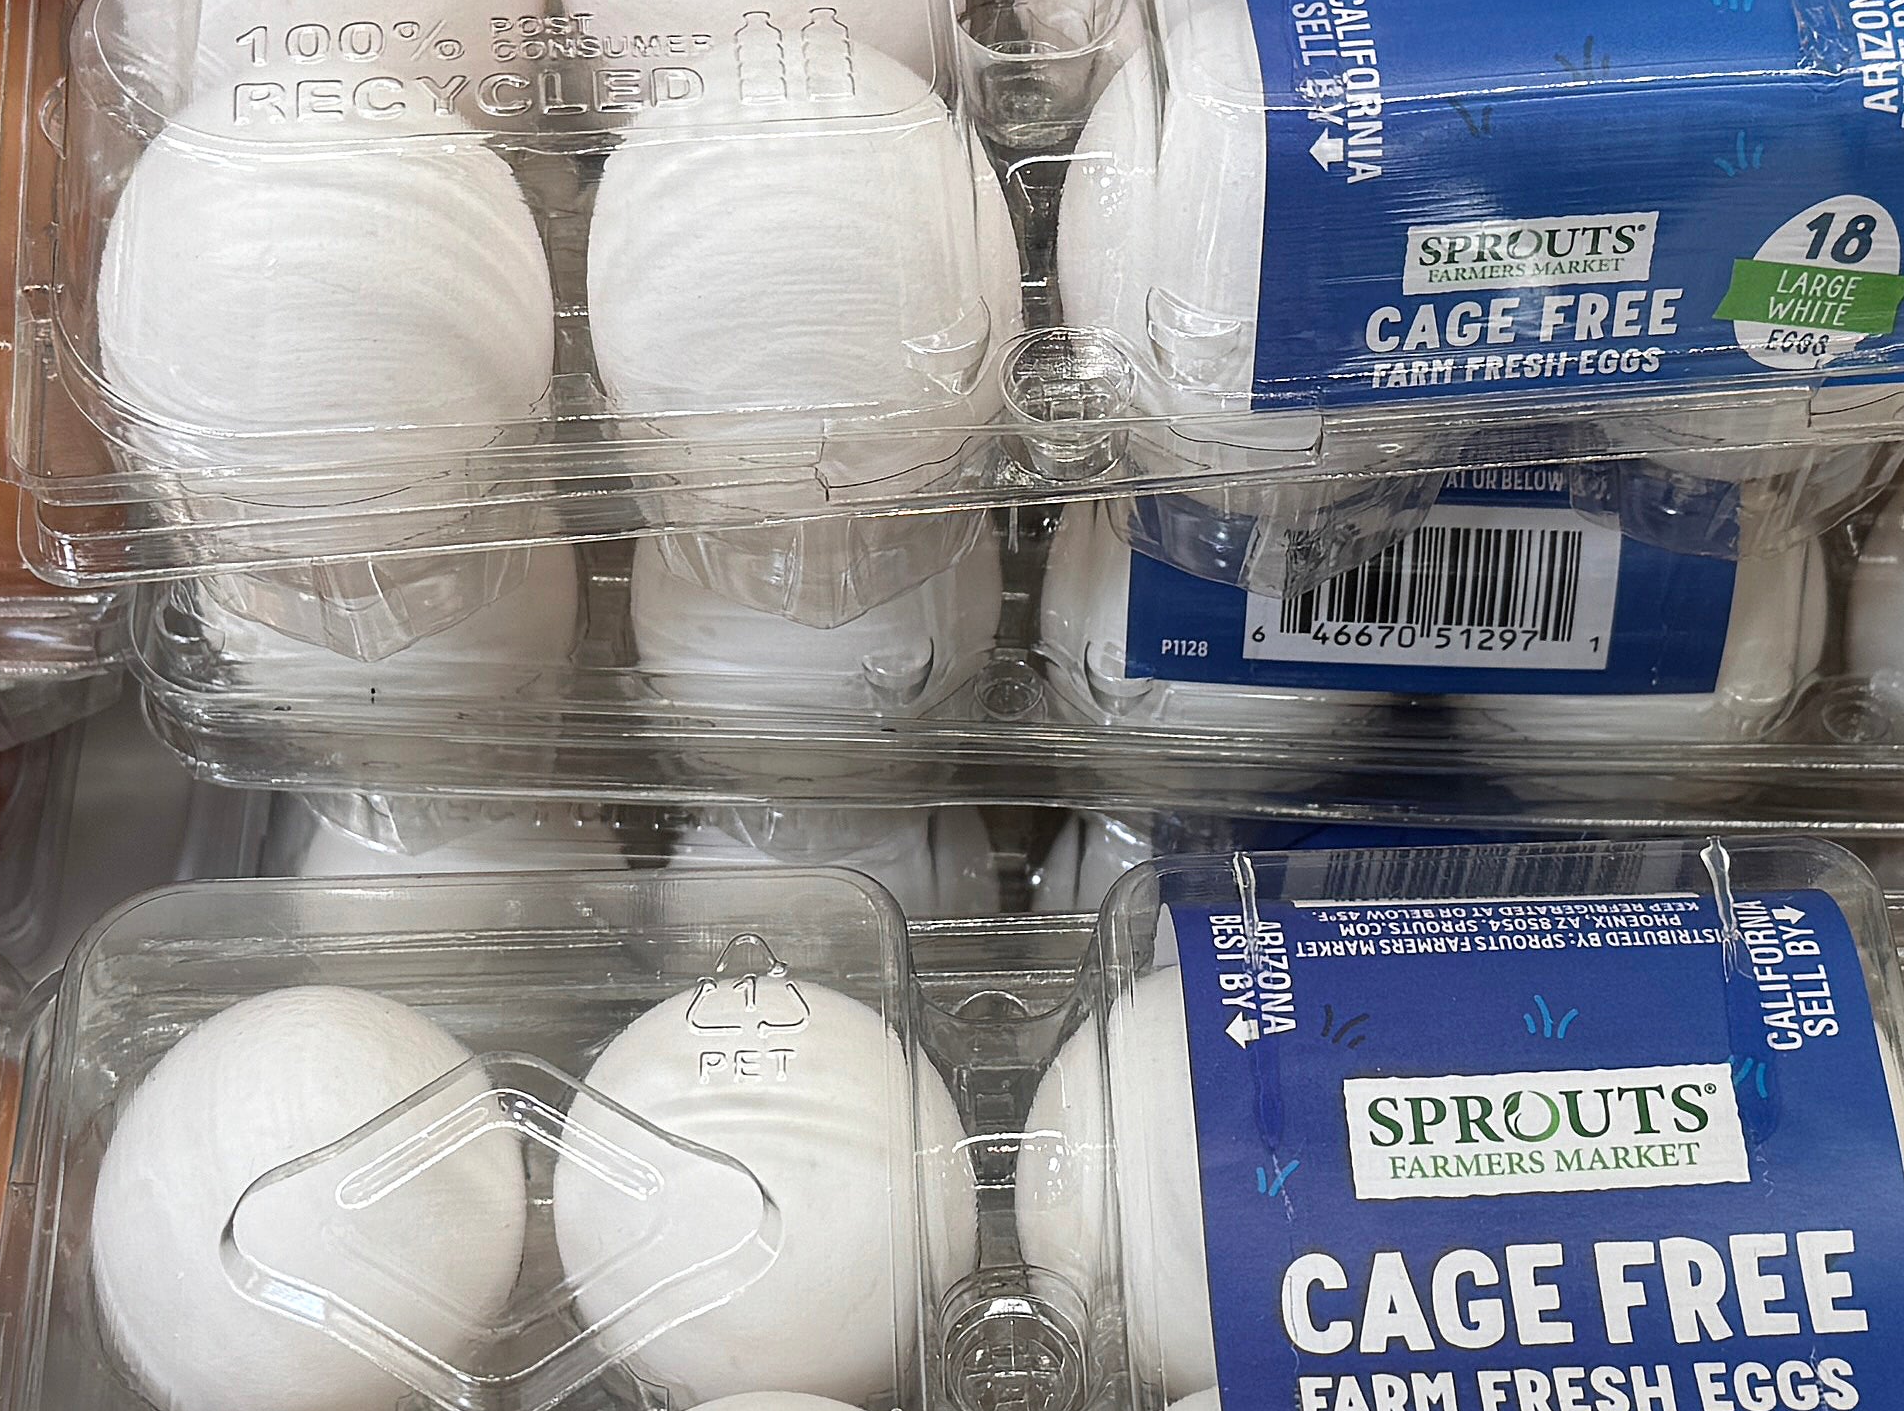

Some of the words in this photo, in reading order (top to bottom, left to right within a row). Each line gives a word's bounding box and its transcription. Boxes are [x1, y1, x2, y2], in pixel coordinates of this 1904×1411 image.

[235, 19, 465, 65] 100%
[233, 68, 704, 125] RECYCLED
[1805, 214, 1875, 262] 18
[1777, 269, 1863, 301] LARGE
[1365, 297, 1515, 353] CAGE
[1533, 288, 1684, 343] FREE
[1768, 298, 1849, 327] WHITE
[1161, 638, 1209, 657] P1128
[1312, 625, 1417, 650] 46670
[1435, 627, 1539, 652] 51297
[1366, 908, 1437, 920] BELOW
[1498, 902, 1645, 916] REFRIGERATED
[1340, 920, 1477, 937] SPROUTS.COM
[1481, 917, 1552, 932] 85054.
[1557, 916, 1579, 930] AZ
[1382, 938, 1473, 956] FARMERS
[1477, 934, 1566, 953] SPROUTS
[1571, 932, 1605, 949] BY:
[1609, 928, 1726, 950] ISTRIBUTED
[1296, 941, 1378, 959] MARKET
[1389, 1149, 1546, 1180] FARMERS
[1555, 1141, 1700, 1173] MARKET
[1280, 1242, 1573, 1354] CAGE
[1593, 1229, 1869, 1345] FREE
